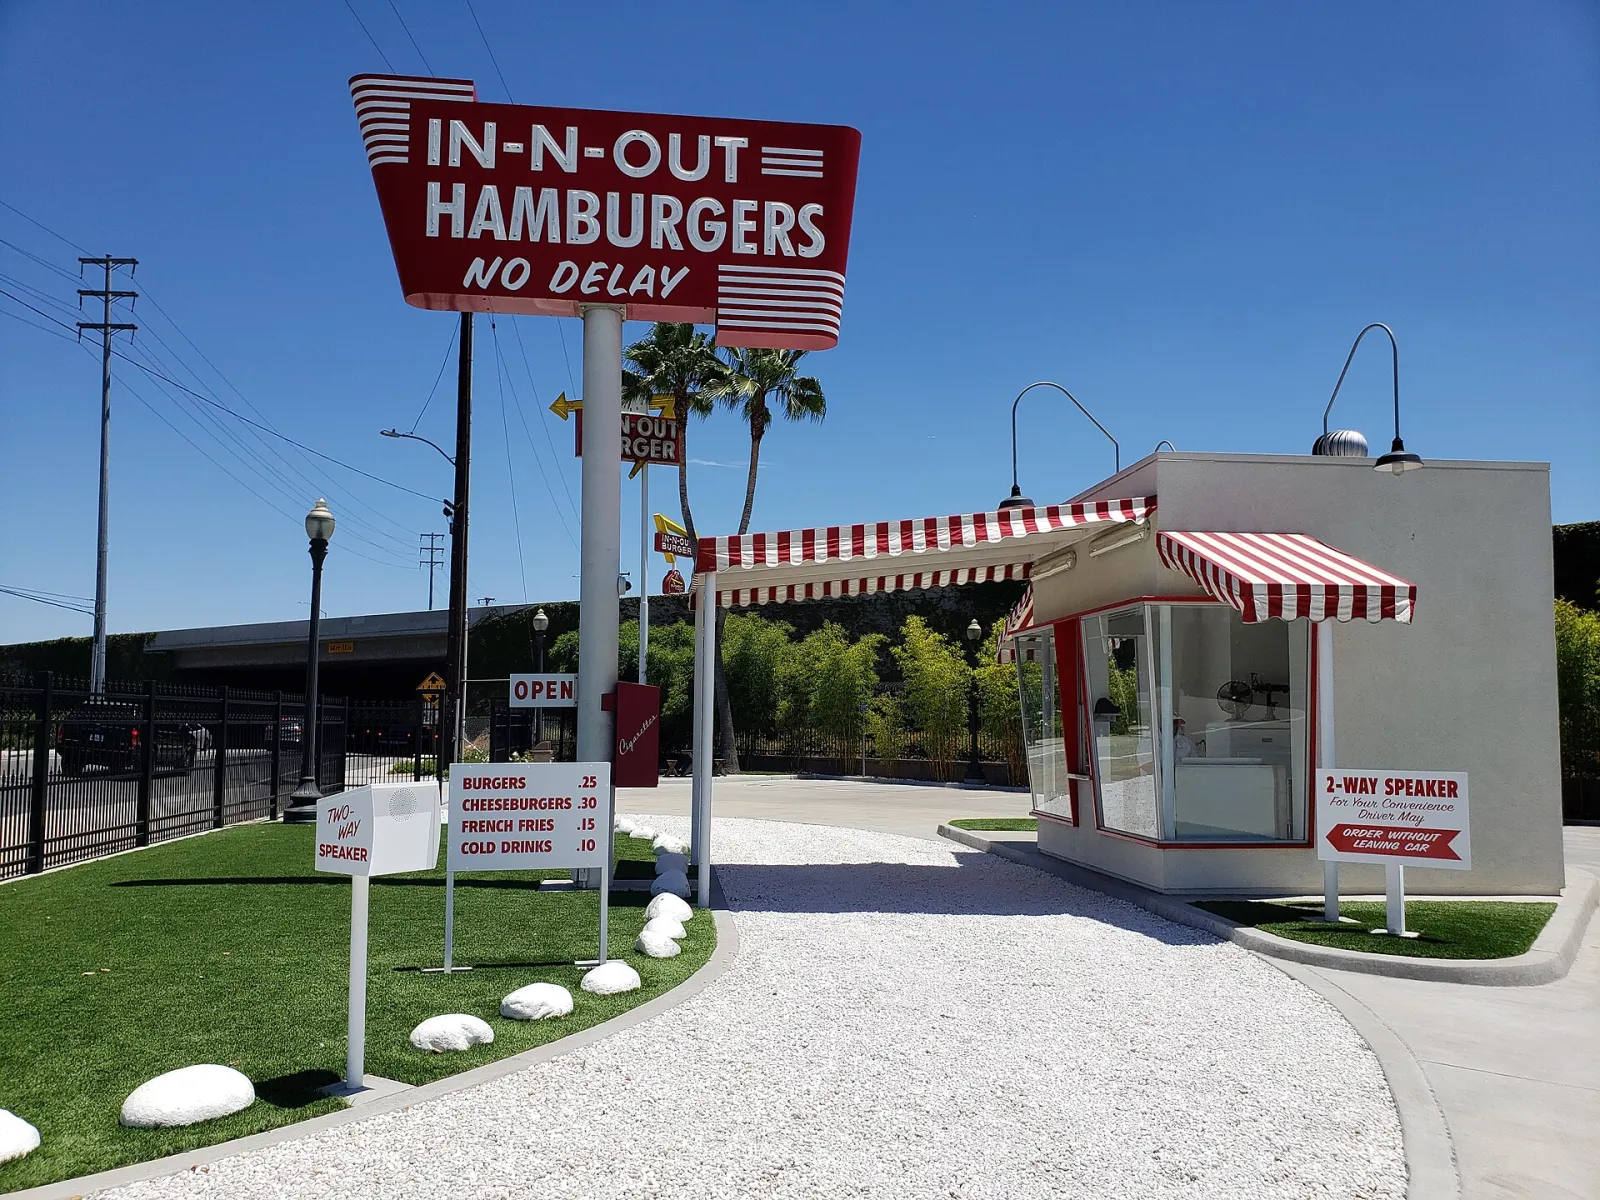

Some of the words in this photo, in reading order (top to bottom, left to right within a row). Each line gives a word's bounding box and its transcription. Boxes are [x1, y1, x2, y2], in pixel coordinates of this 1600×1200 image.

[427, 118, 748, 183] IN-N-OUT
[426, 181, 826, 258] HAMBURGERS
[463, 256, 531, 290] NO
[548, 260, 690, 299] DELAY
[620, 415, 677, 439] N-OUT
[620, 436, 676, 460] RGER
[661, 534, 689, 547] IN-N-OU
[661, 542, 692, 556] BURGER
[514, 680, 573, 700] OPEN
[619, 714, 658, 756] Cigarettes
[462, 777, 527, 790] BURGERS
[577, 775, 598, 789] .25
[1326, 776, 1378, 795] 2-WAY
[1384, 778, 1458, 798] SPEAKER
[461, 797, 572, 811] CHEESEBURGERS
[577, 796, 598, 810] .30
[1329, 796, 1349, 807] For
[1352, 797, 1379, 809] Your
[1381, 798, 1455, 812] Convenience
[327, 804, 355, 824] TWO-
[1357, 809, 1396, 821] Driver
[1397, 811, 1425, 827] May
[338, 818, 361, 841] WAY
[461, 820, 513, 833] FRENCH
[518, 818, 555, 832] FRIES
[576, 817, 596, 831] .15
[1342, 828, 1384, 838] ORDER
[1387, 830, 1442, 842] WITHOUT
[318, 843, 368, 862] SPEAKER
[460, 841, 496, 854] COLD
[501, 839, 553, 854] DRINKS
[576, 838, 596, 852] .10
[1352, 839, 1400, 850] LEAVING
[1404, 842, 1430, 852] CAR
